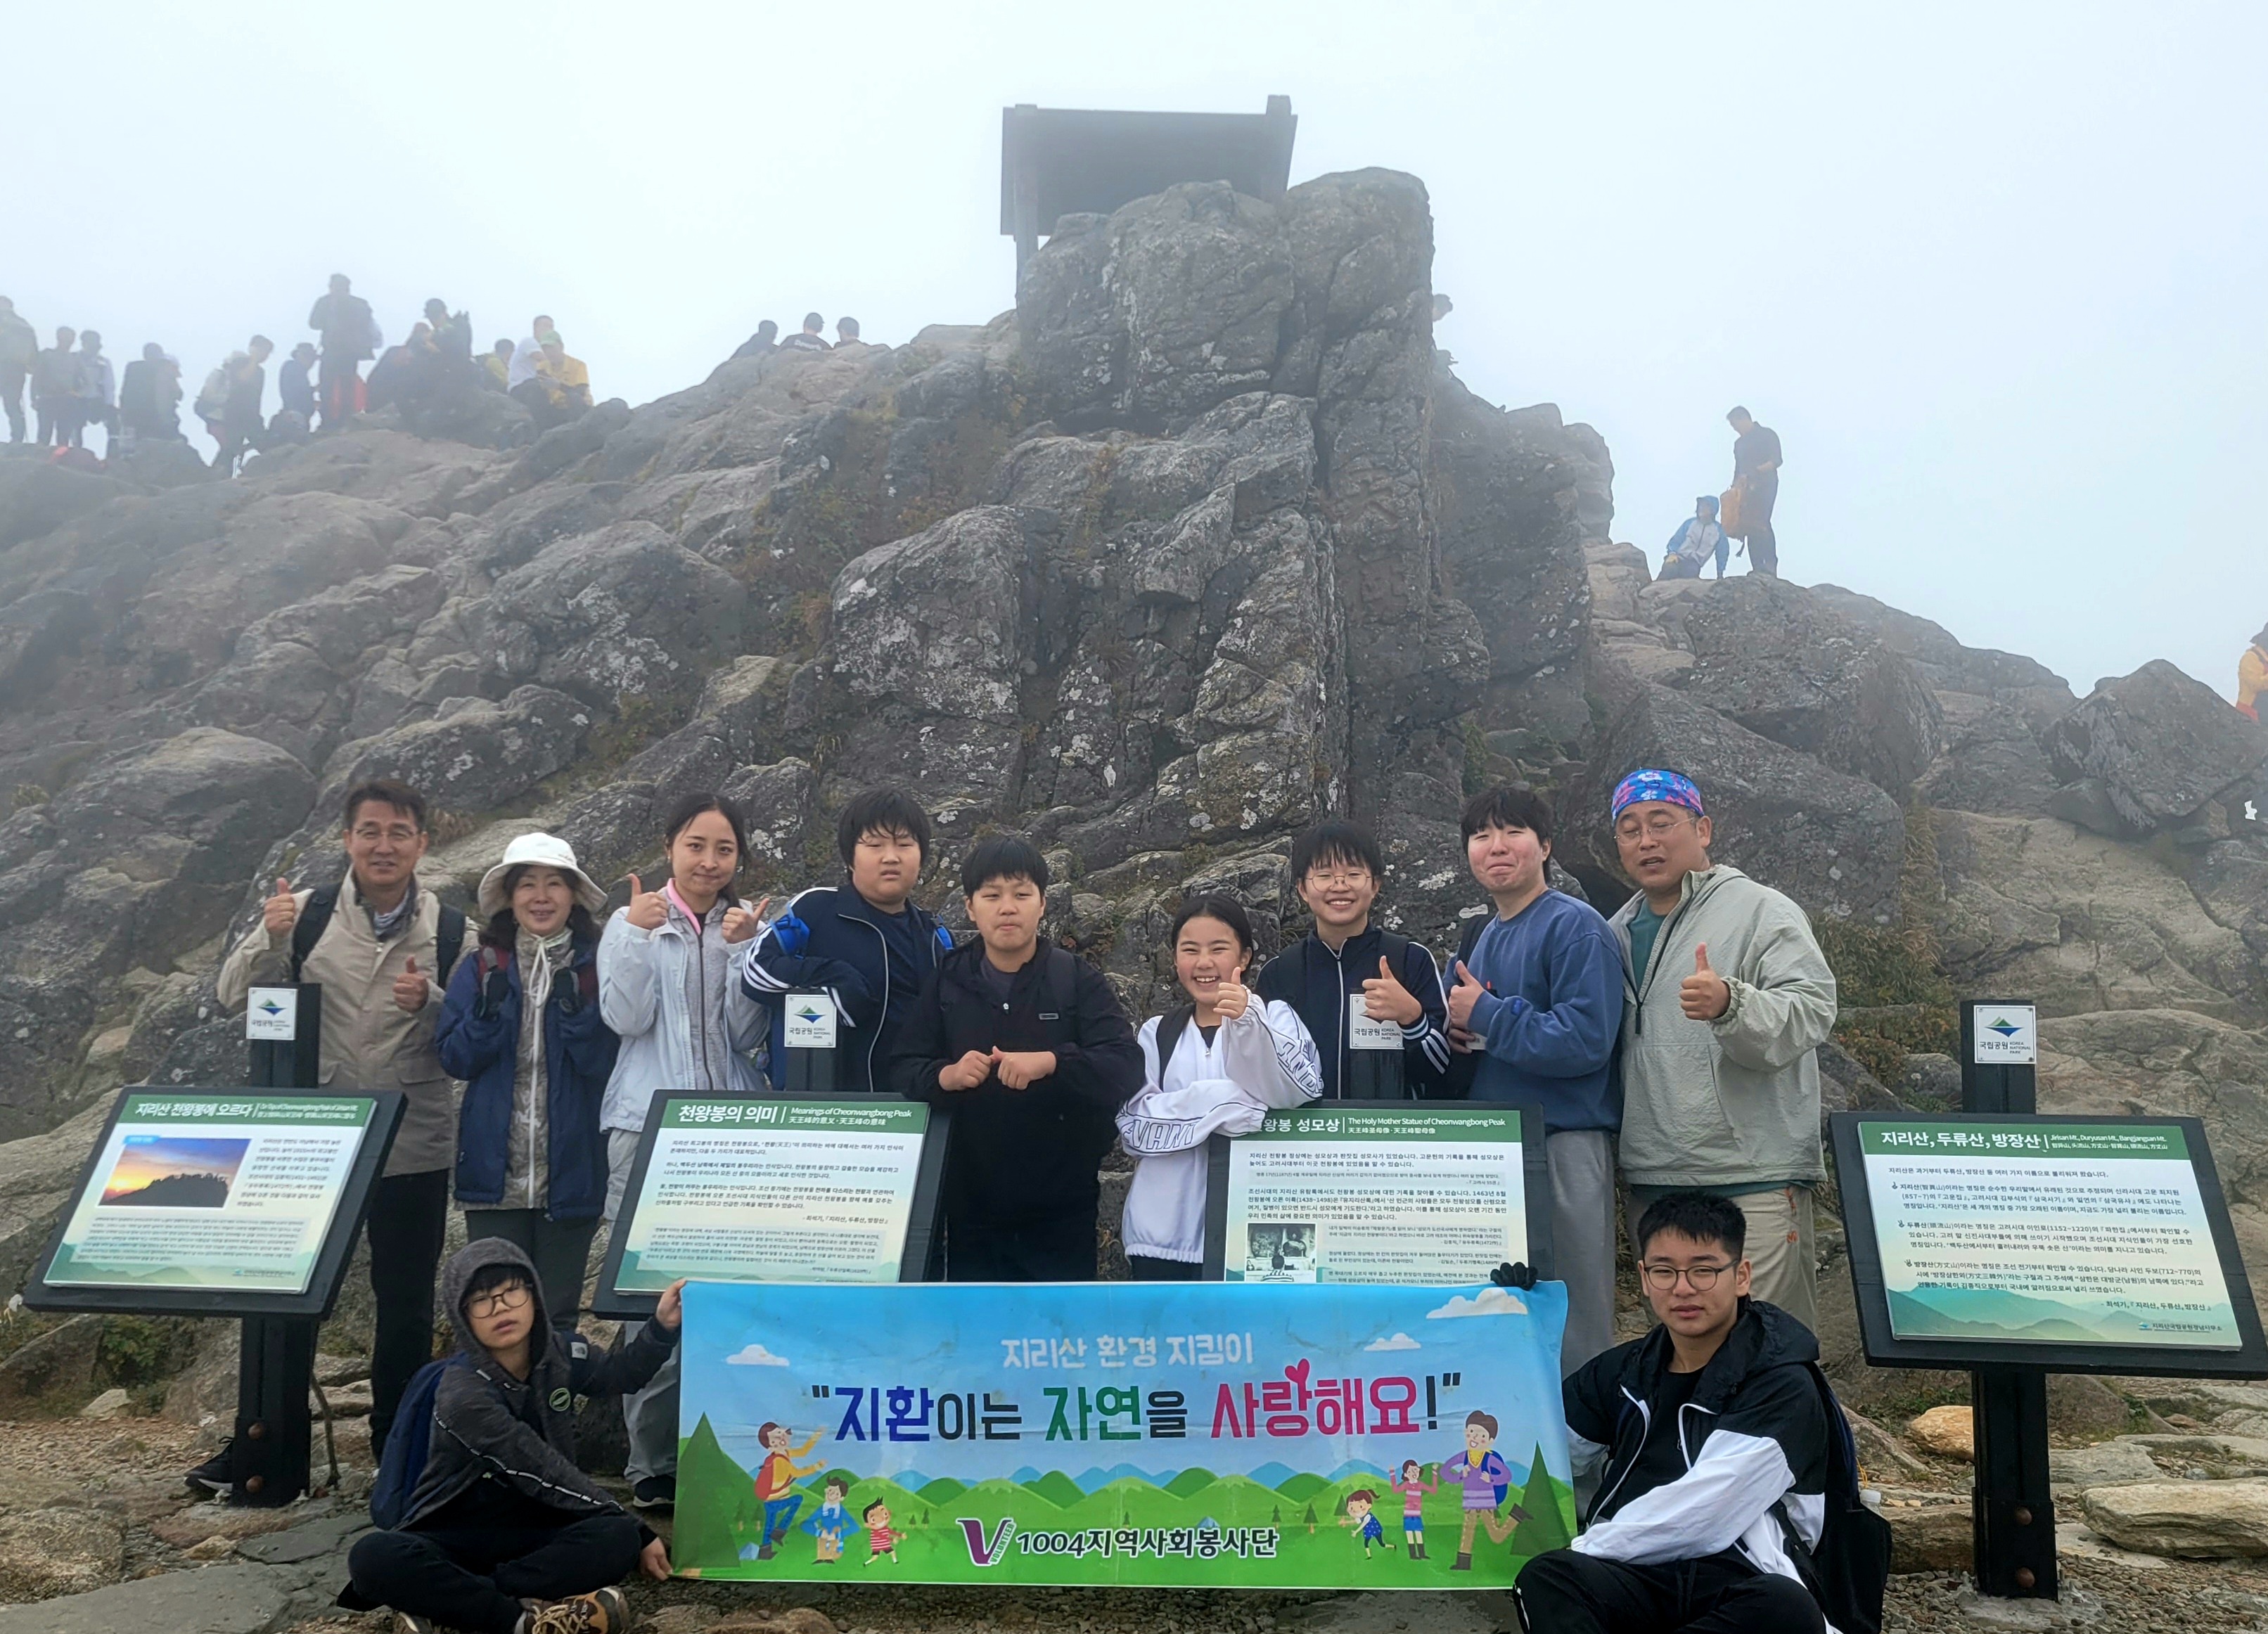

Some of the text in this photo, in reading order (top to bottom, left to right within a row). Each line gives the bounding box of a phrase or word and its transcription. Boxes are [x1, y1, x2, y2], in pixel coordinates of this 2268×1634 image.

[1980, 1041, 2008, 1050] 국립공원
[136, 1102, 172, 1117] 지리산
[216, 1104, 254, 1117] 오르다
[679, 1105, 779, 1124] 천왕봉의 의미
[791, 1107, 825, 1117] Meanings
[833, 1108, 895, 1119] Cheonwangbong
[1258, 1118, 1340, 1133] 왕봉 성모상
[1362, 1117, 1377, 1126] Holy
[1378, 1117, 1402, 1126] Mother
[1430, 1118, 1488, 1128] Cheonwangbong
[1881, 1131, 2041, 1149] 지리산, 두류산, 방장산
[1001, 1332, 1253, 1369] 지리산 환경 지킴이
[812, 1358, 1461, 1442] "지환이는 자연을 사랑해요!"
[1016, 1528, 1279, 1557] 1004지역사회봉사단
